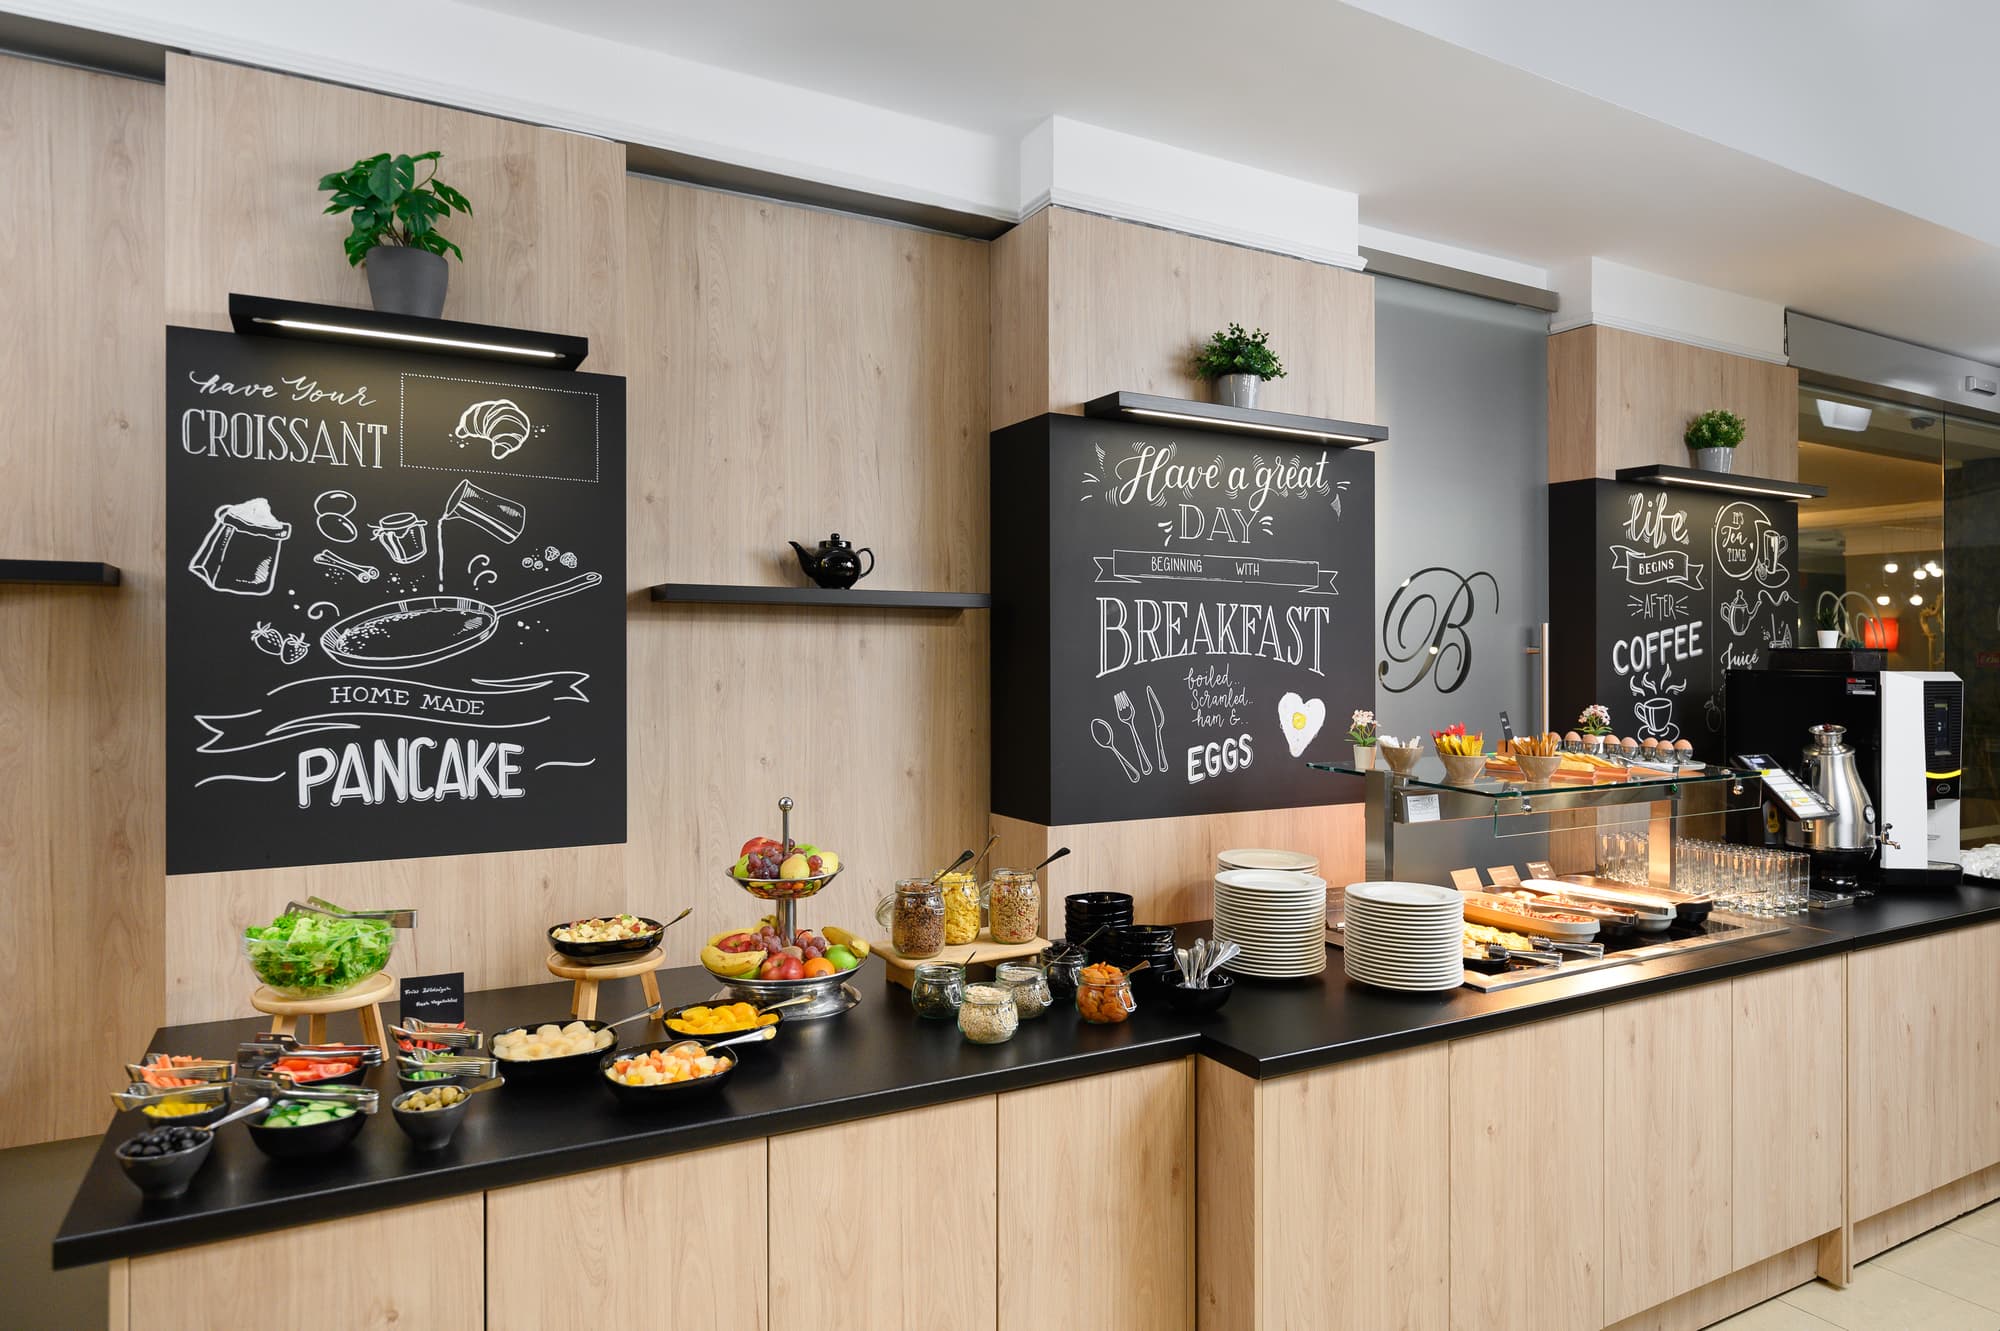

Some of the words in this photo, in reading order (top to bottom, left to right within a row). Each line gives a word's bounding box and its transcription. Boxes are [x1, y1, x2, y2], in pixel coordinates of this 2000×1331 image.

[188, 370, 279, 400] have
[280, 375, 377, 408] Your
[181, 407, 389, 470] CROISSANT
[1115, 445, 1221, 505] Have
[1228, 466, 1250, 490] a
[1248, 450, 1331, 512] great
[1178, 503, 1261, 545] DAY
[1622, 492, 1689, 549] life
[1720, 524, 1748, 548] Tea
[1150, 556, 1203, 574] BEGINNING
[1235, 562, 1261, 577] WITH
[1638, 559, 1675, 576] BEGINS
[1726, 547, 1747, 563] TIME
[1643, 593, 1677, 621] AFTER
[1095, 596, 1331, 678] BREAKFAST
[1378, 566, 1500, 694] B
[1612, 620, 1704, 676] COFFEE
[1720, 641, 1760, 670] Juice
[329, 685, 410, 707] HOME
[419, 693, 486, 716] MADE
[1191, 708, 1225, 728] ham
[297, 736, 526, 809] PANCAKE
[1187, 733, 1254, 785] EGGS
